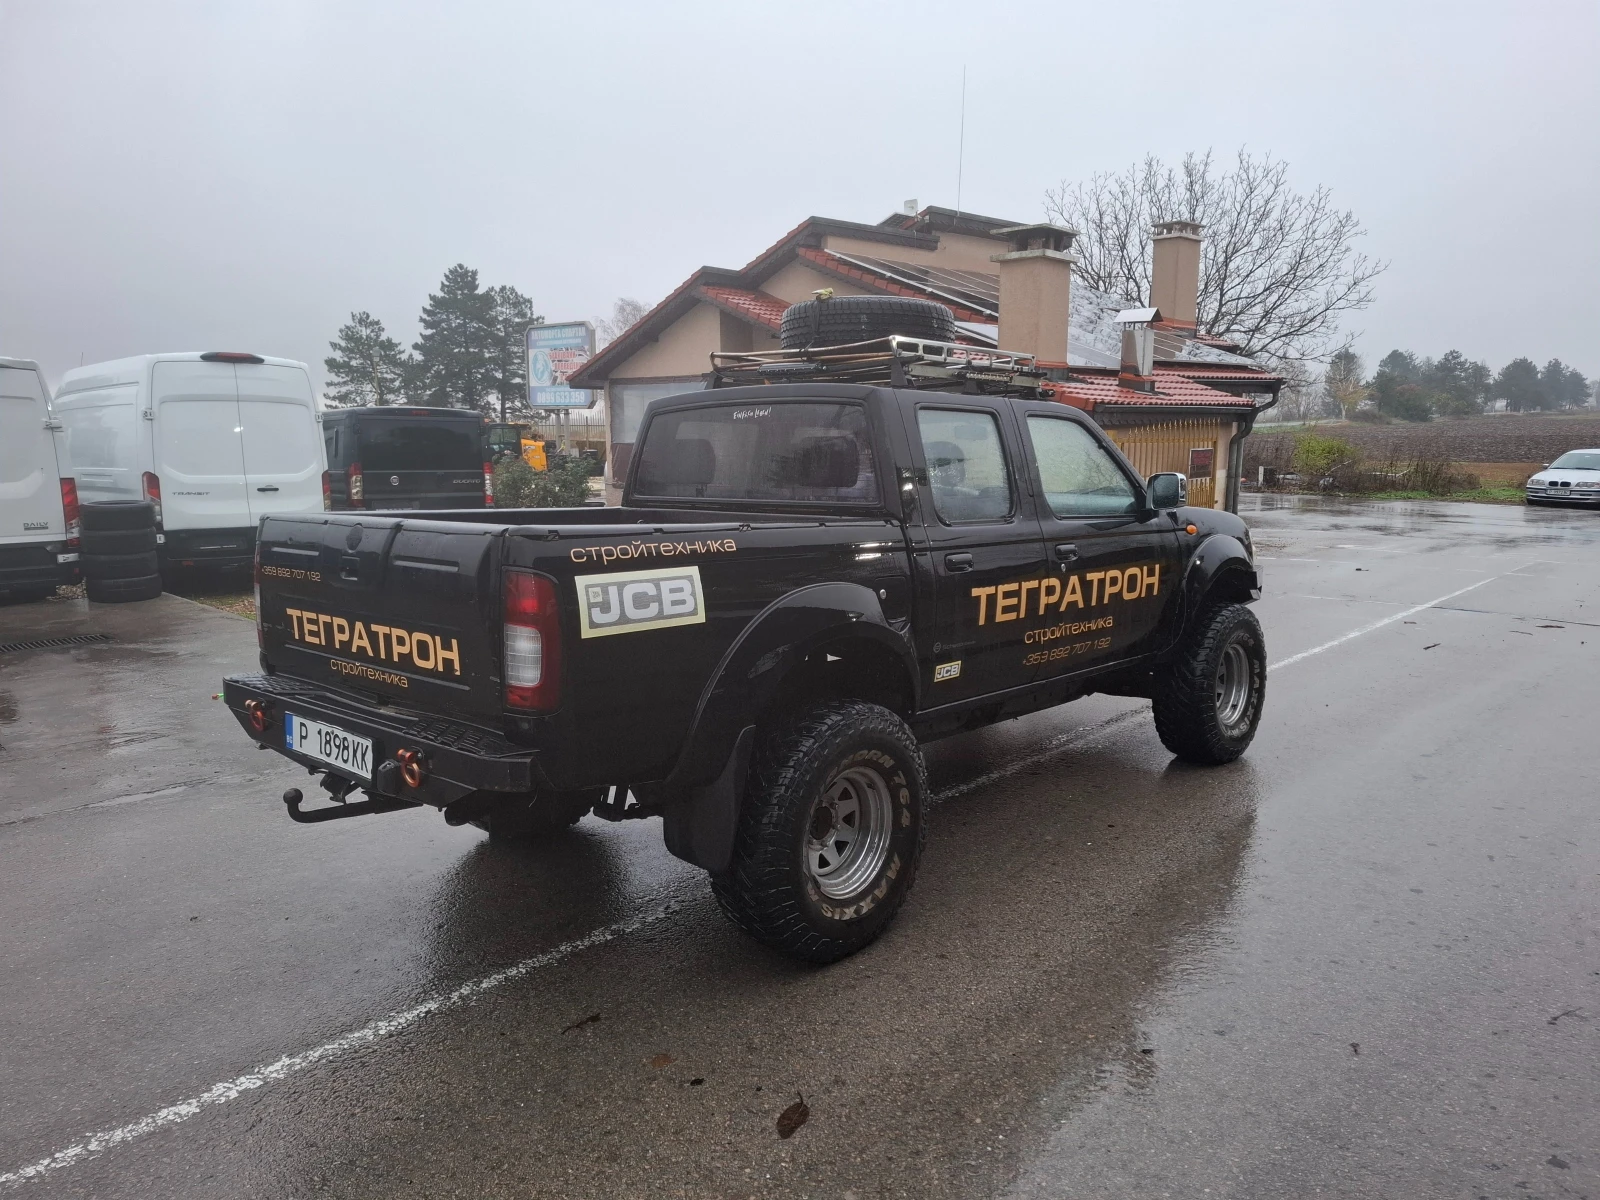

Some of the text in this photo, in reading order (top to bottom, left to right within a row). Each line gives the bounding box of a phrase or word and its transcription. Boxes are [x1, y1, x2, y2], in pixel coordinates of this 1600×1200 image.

[537, 391, 585, 403] 0899 633 359
[570, 538, 737, 565] стройтехника
[277, 567, 291, 578] 892
[291, 569, 306, 579] 707
[307, 571, 321, 582] 192
[589, 578, 696, 625] JCB
[971, 563, 1160, 626] ТЕГРАТРОН
[286, 607, 461, 676] ТЕГРАТРОН
[1024, 615, 1113, 645] стройтехника
[1049, 645, 1071, 660] 892
[1071, 641, 1092, 655] 707
[1093, 636, 1112, 650] 192
[330, 659, 409, 688] стройтехника
[936, 664, 959, 679] JCB
[820, 851, 901, 921] MAXXIS
